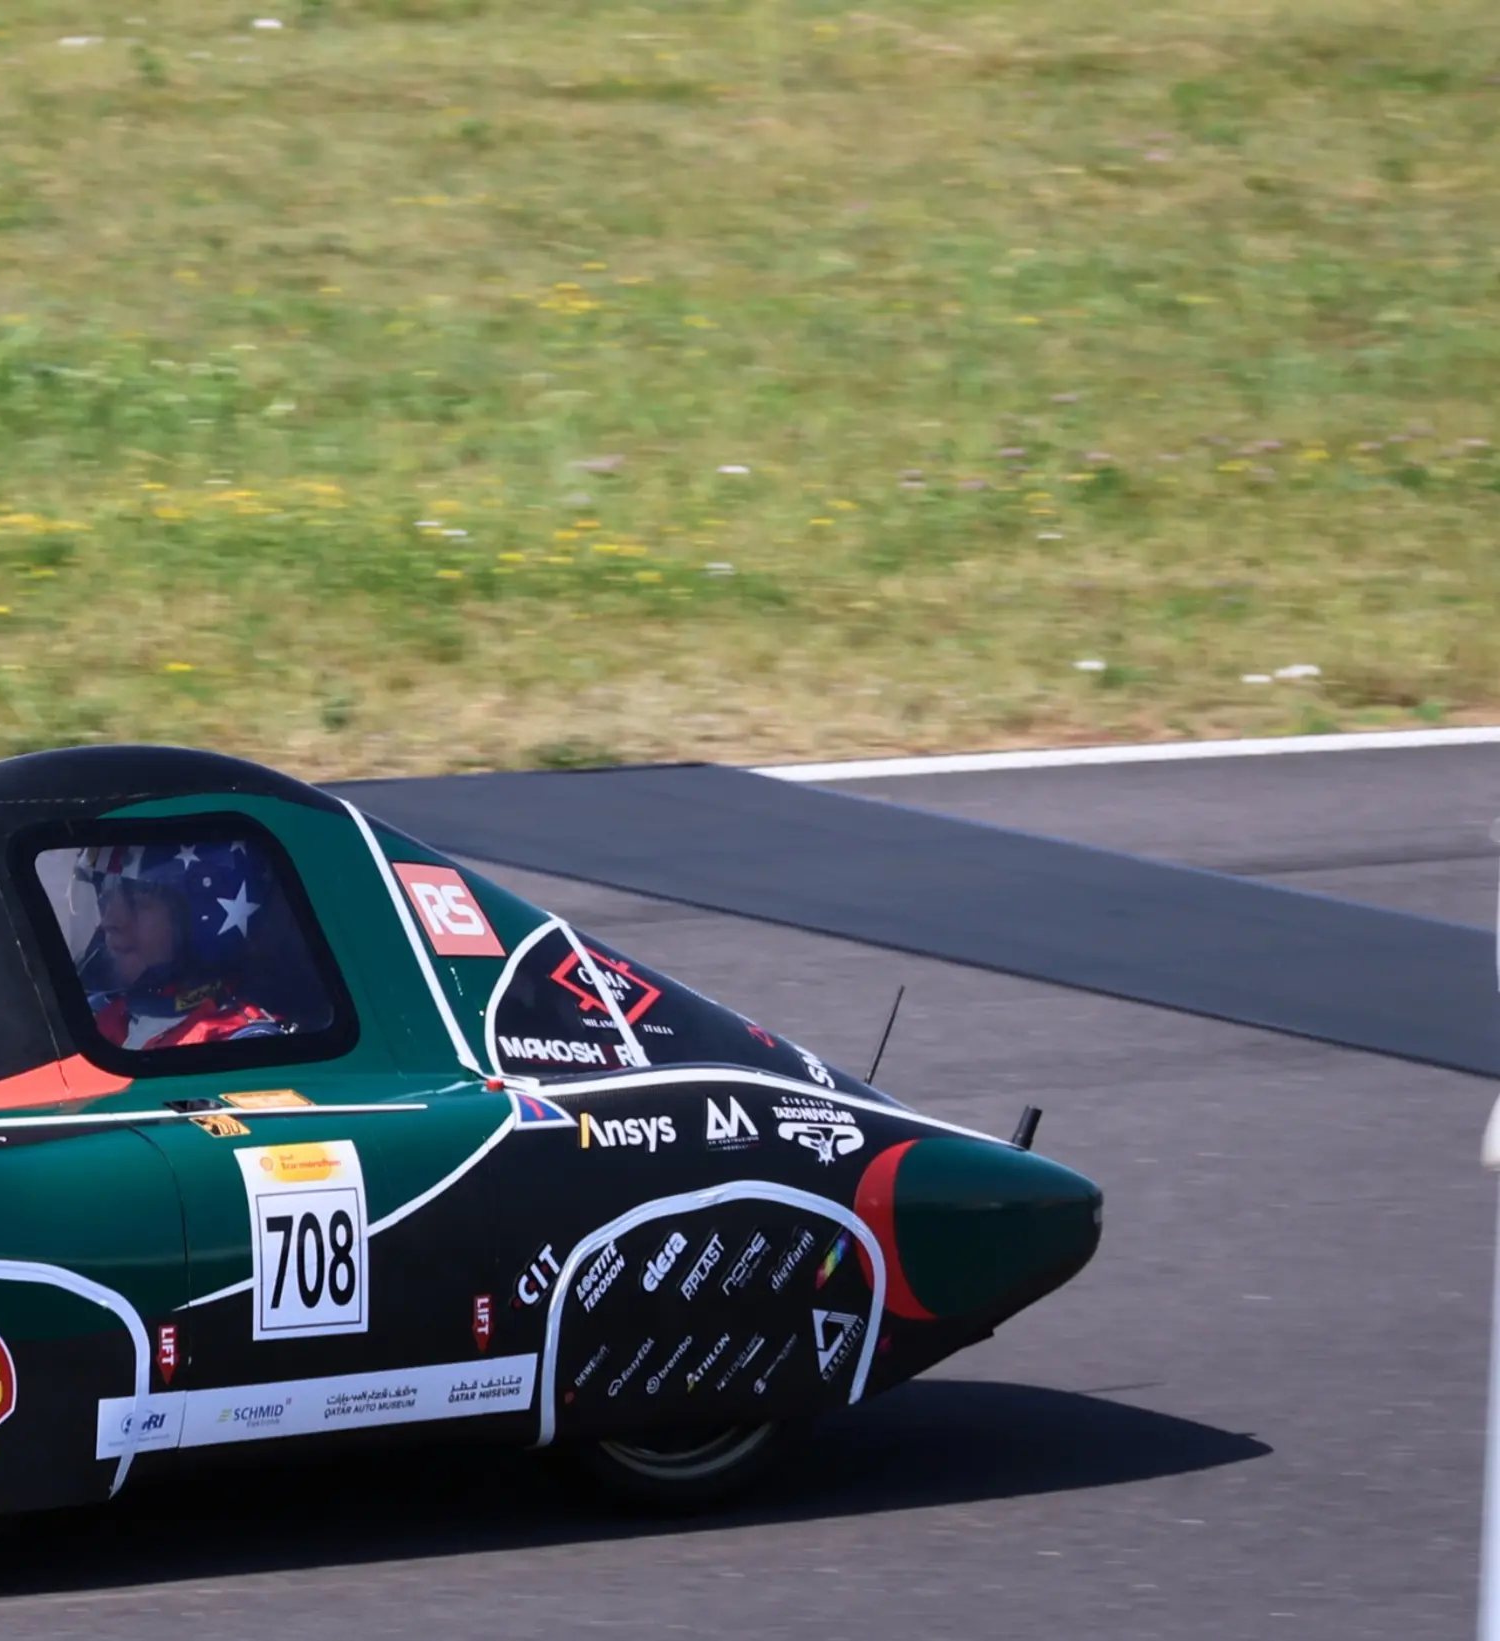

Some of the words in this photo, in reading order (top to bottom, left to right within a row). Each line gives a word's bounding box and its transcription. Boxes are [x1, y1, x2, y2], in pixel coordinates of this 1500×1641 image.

[410, 883, 485, 936] RS
[577, 966, 632, 991] CMA
[642, 1023, 674, 1036] ITALIA
[498, 1036, 607, 1066] MAKOSH
[781, 1096, 834, 1109] CIRCUITO
[580, 1111, 677, 1153] Ansys
[265, 1209, 356, 1310] 708
[575, 1241, 619, 1301] LOCTITE
[642, 1231, 688, 1292] elesa
[583, 1255, 626, 1313] TEROSON
[477, 1297, 490, 1336] LIFT
[161, 1327, 175, 1367] LIFT
[621, 1337, 655, 1382] EasyEDA
[658, 1335, 693, 1380] brembo
[233, 1403, 284, 1422] SCHMID
[323, 1402, 352, 1419] QATAR
[352, 1402, 377, 1415] AUTO
[377, 1398, 416, 1412] MUSEUM
[448, 1390, 476, 1404] QATAR
[478, 1386, 522, 1400] MUSEUMS
